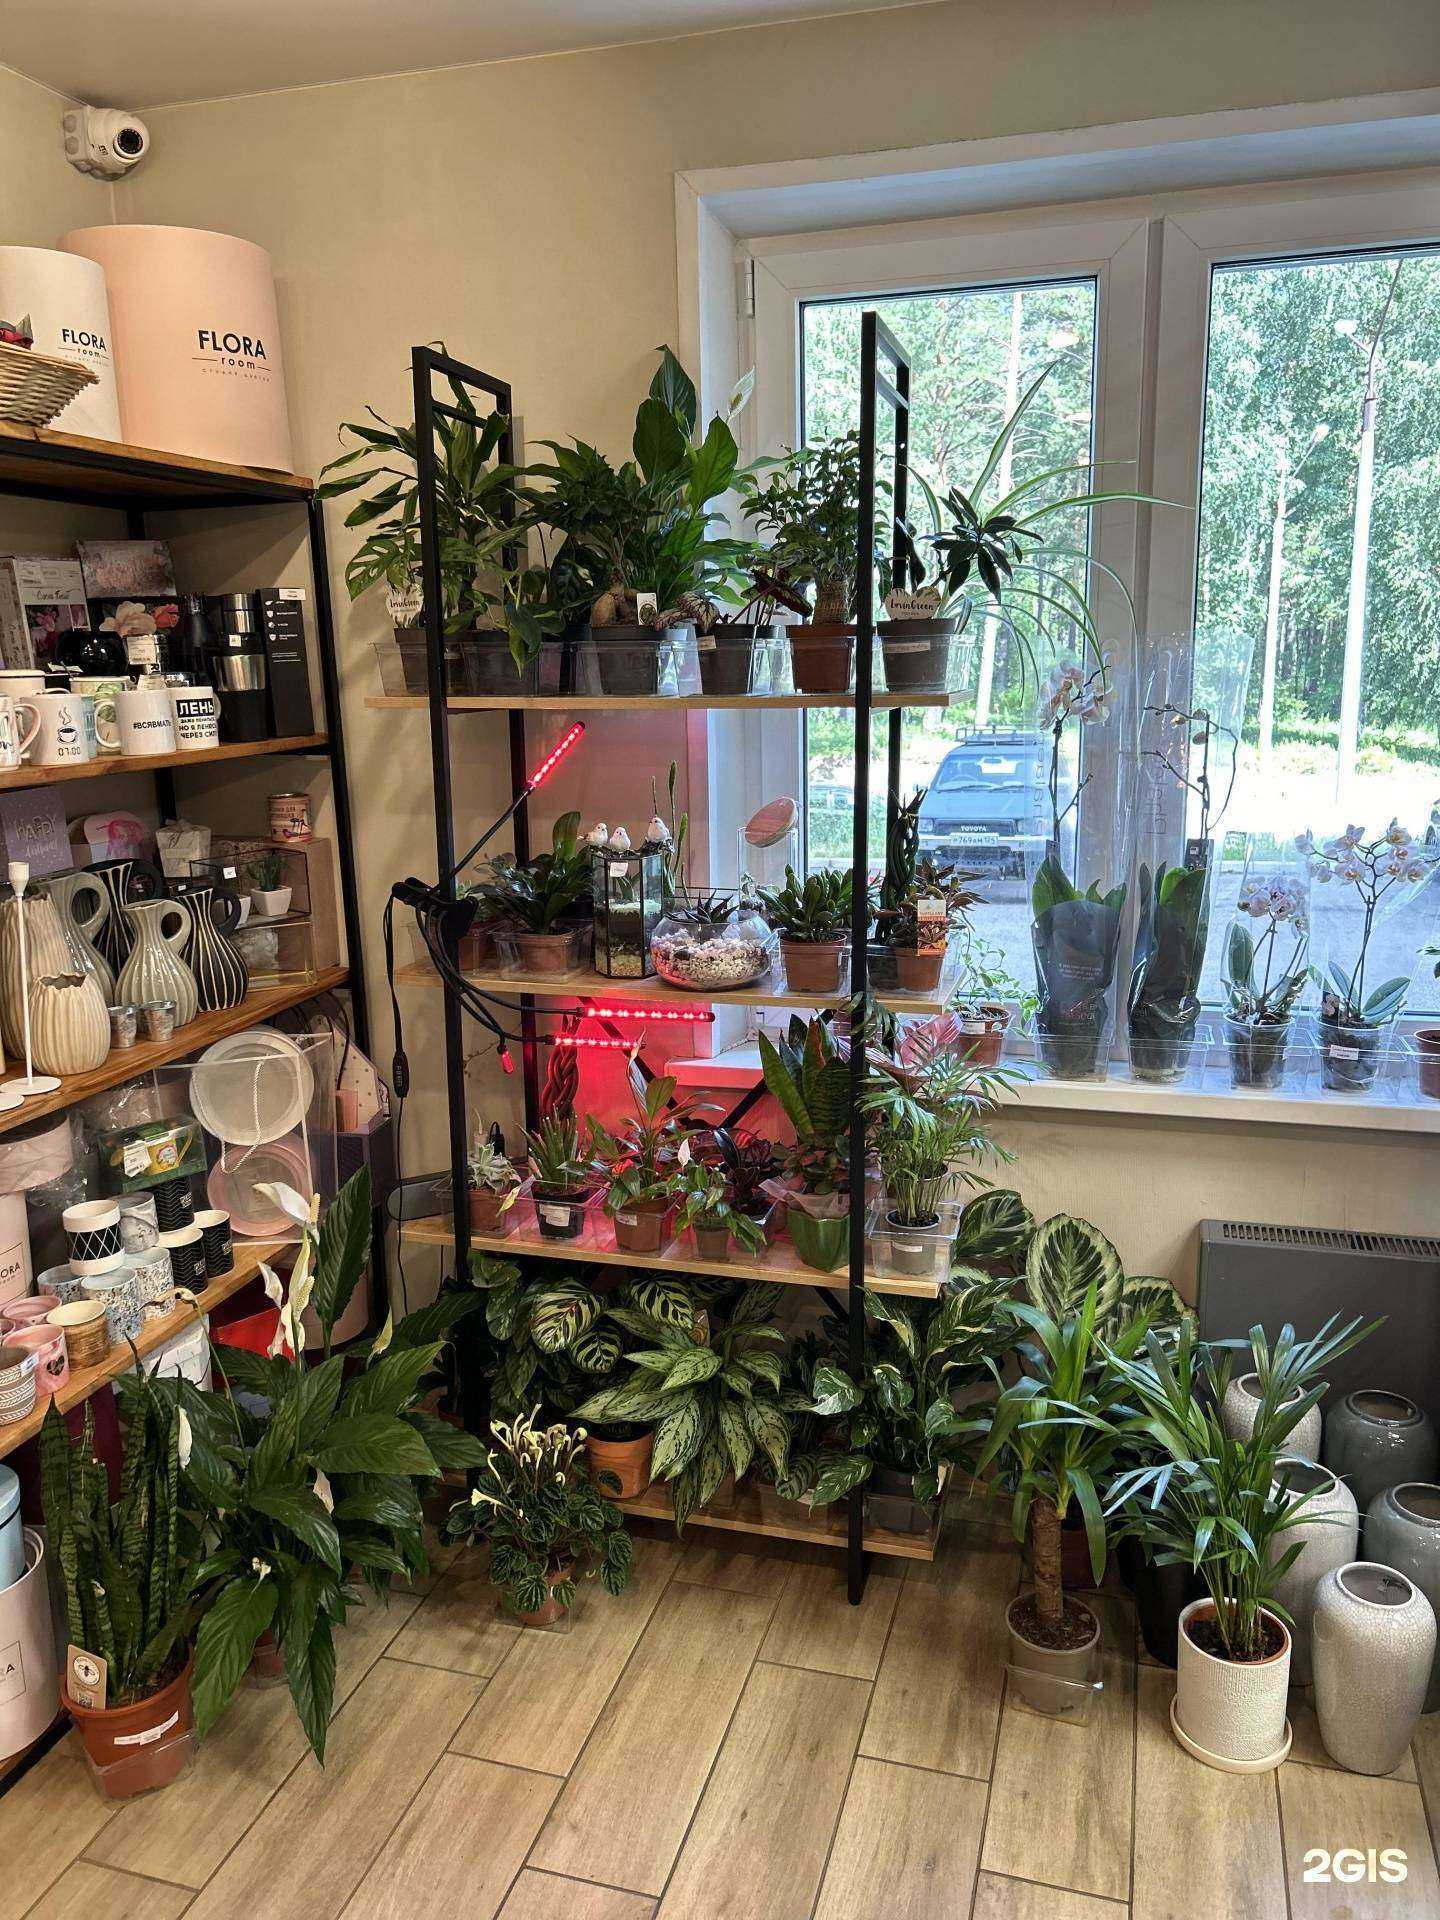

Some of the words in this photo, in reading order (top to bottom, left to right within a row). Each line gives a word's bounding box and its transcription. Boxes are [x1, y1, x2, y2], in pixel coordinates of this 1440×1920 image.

[61, 328, 107, 352] FLORA
[198, 329, 267, 360] FLORA
[77, 348, 101, 358] room
[221, 357, 256, 370] room
[179, 701, 214, 715] ЛЕНЬ
[961, 824, 987, 832] TOYOTA
